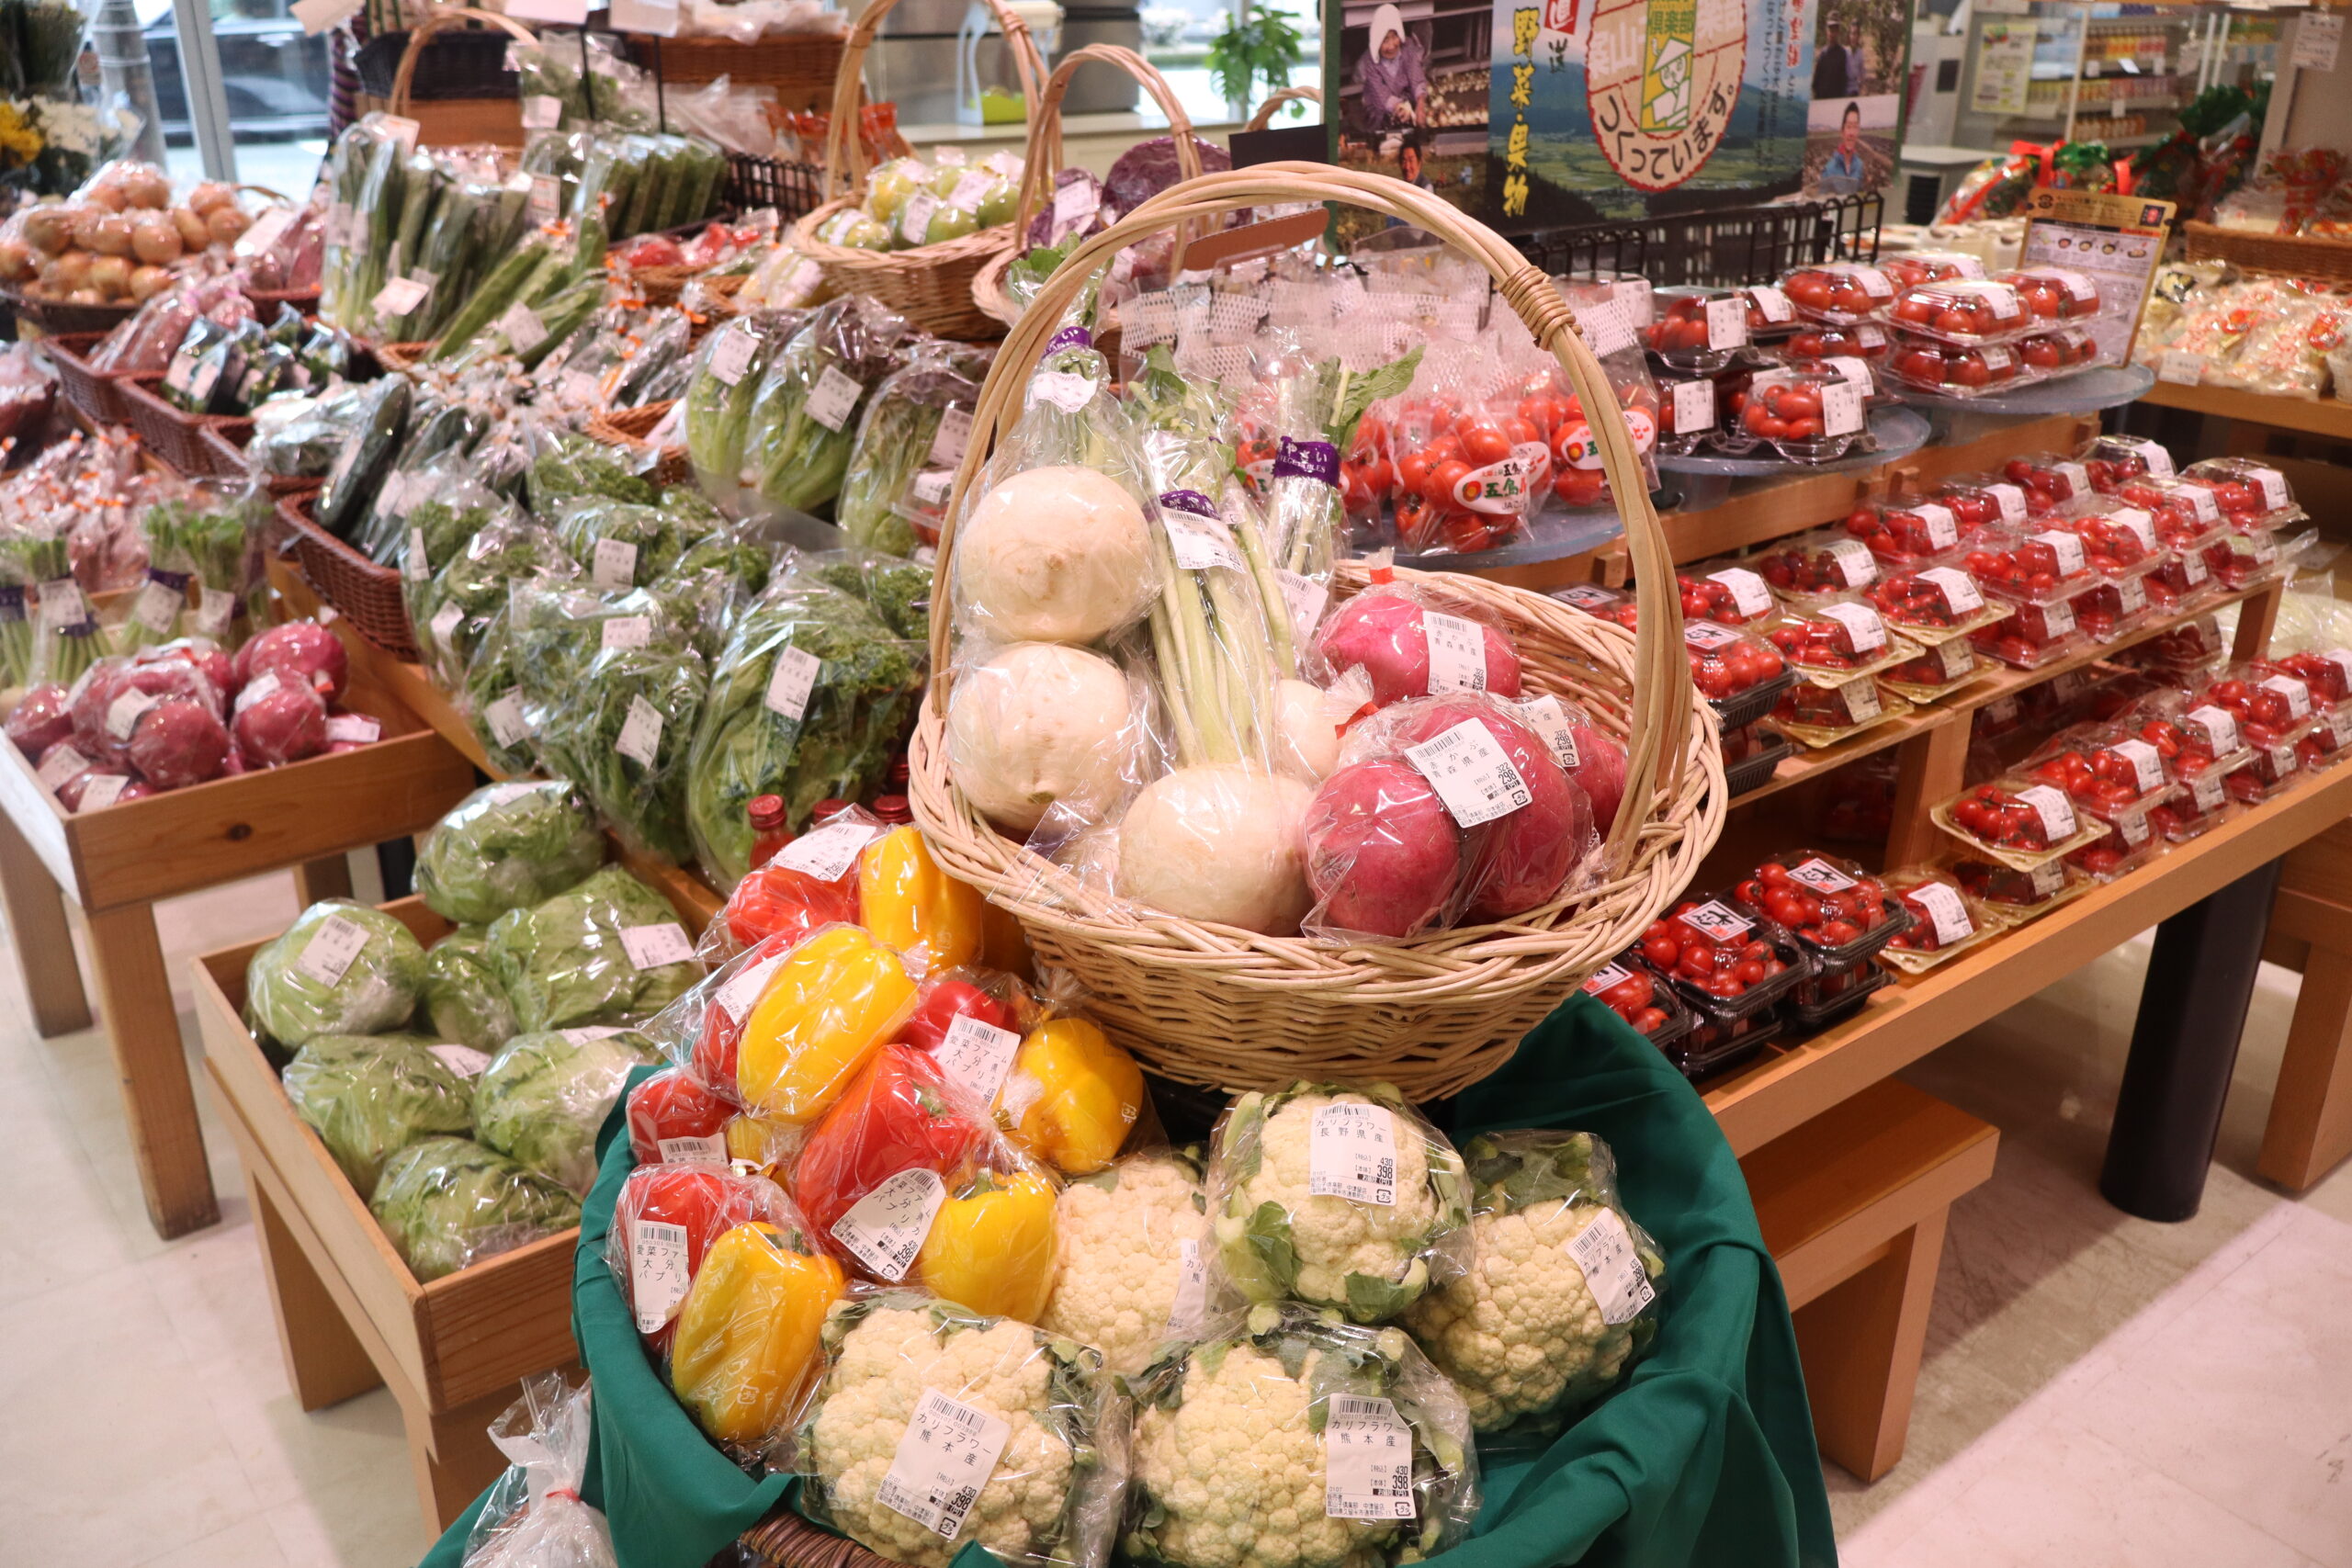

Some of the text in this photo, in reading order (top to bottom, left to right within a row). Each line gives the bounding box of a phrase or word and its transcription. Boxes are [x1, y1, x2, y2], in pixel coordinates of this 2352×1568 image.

[1502, 7, 1541, 218] 野菜・果物
[1600, 81, 1735, 180] つくっています。
[1473, 673, 1485, 686] 298
[1555, 735, 1572, 746] 298
[1496, 761, 1510, 773] 322
[1498, 769, 1518, 785] 298
[1316, 1117, 1386, 1133] カリフラワー
[1320, 1126, 1384, 1144] 長野県産
[1380, 1157, 1394, 1168] 430
[1376, 1165, 1393, 1179] 398
[897, 1243, 914, 1263] 398
[917, 1412, 992, 1455] カリフラワー
[1331, 1420, 1407, 1432] カリフラワー
[919, 1428, 978, 1467] 熊本産
[1340, 1433, 1396, 1448] 熊本産
[1396, 1465, 1408, 1475] 430
[1393, 1474, 1408, 1490] 398
[961, 1484, 978, 1499] 430
[950, 1492, 972, 1511] 398
